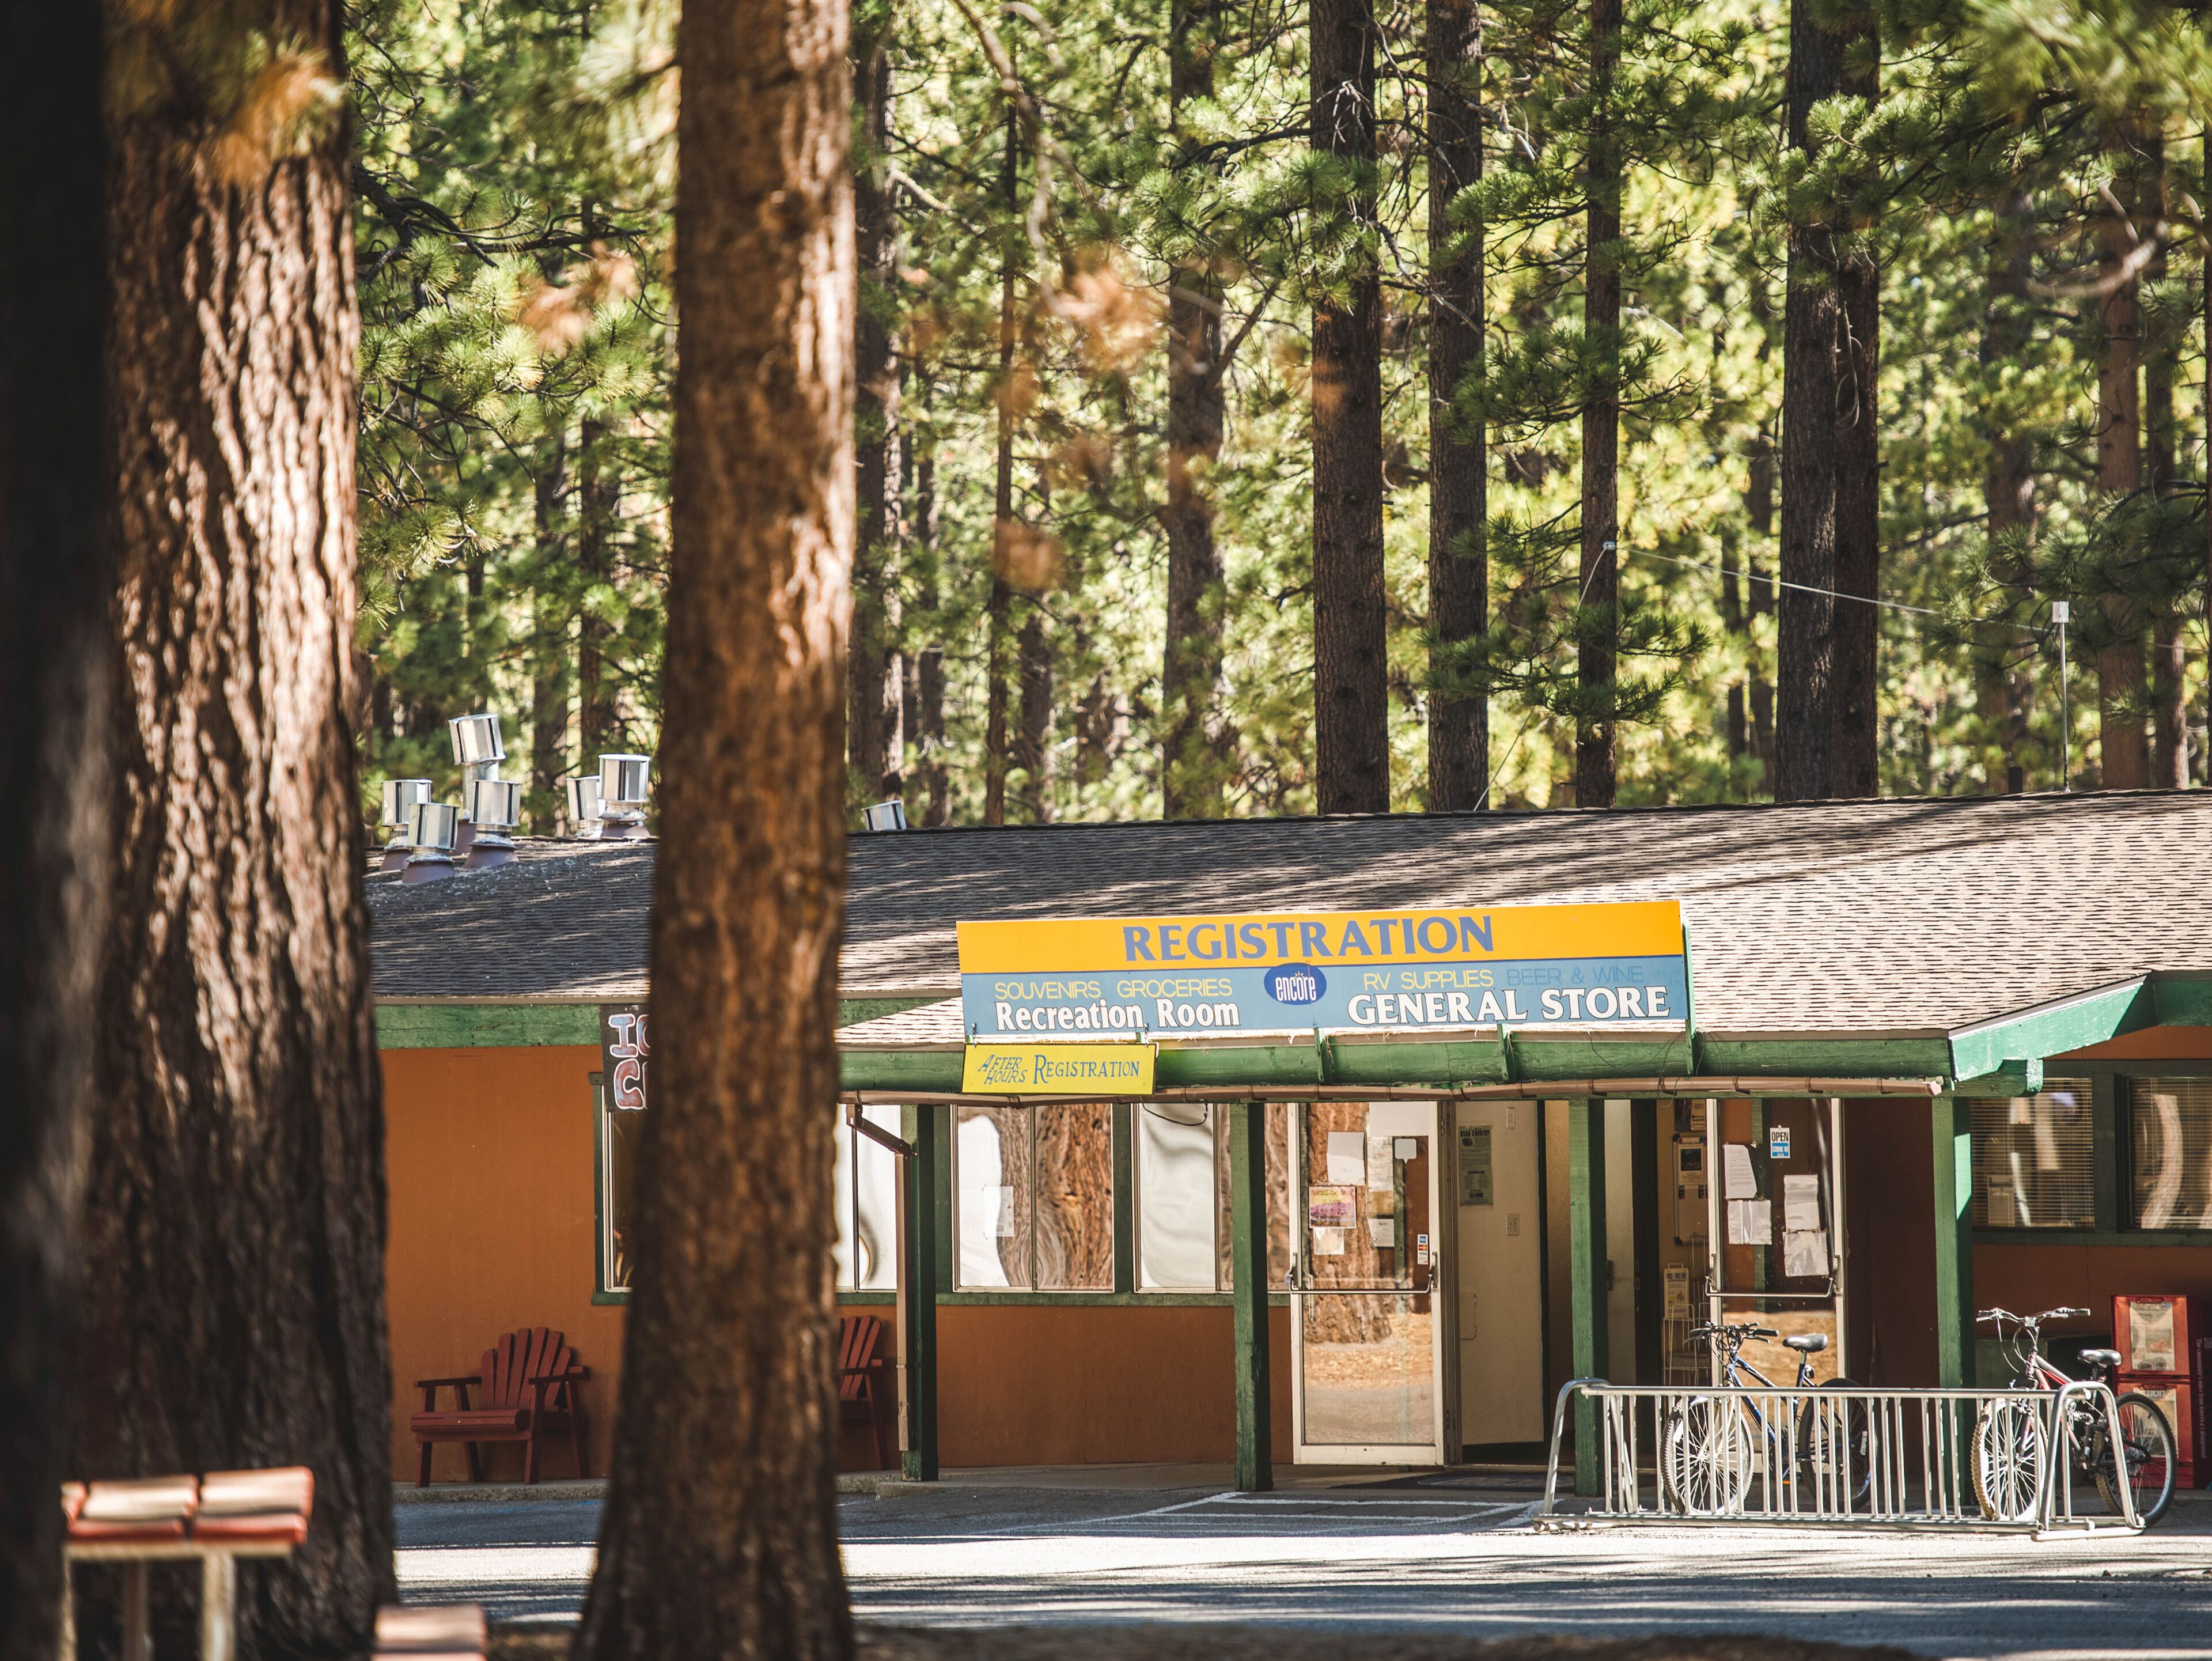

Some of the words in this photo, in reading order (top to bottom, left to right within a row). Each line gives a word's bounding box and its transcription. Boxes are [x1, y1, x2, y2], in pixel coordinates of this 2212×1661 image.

[1123, 915, 1493, 962] REGISTRATION
[995, 981, 1101, 1000] SOUVENIRS
[1117, 978, 1233, 998] GROCERIES
[1275, 976, 1317, 1001] encore
[1364, 973, 1389, 991] RV
[1401, 969, 1494, 989] SUPPLIES
[1507, 968, 1562, 986] BEER
[1571, 968, 1585, 985] &
[1592, 965, 1643, 983] WINE
[995, 998, 1145, 1031] Recreation
[1155, 997, 1241, 1028] Room
[1347, 989, 1528, 1026] GENERAL
[1541, 986, 1671, 1020] STORE
[978, 1054, 1022, 1072] AFTER
[1033, 1054, 1139, 1084] REGISTRATION
[984, 1069, 1028, 1085] HOURS
[1771, 1132, 1789, 1142] OPEN
